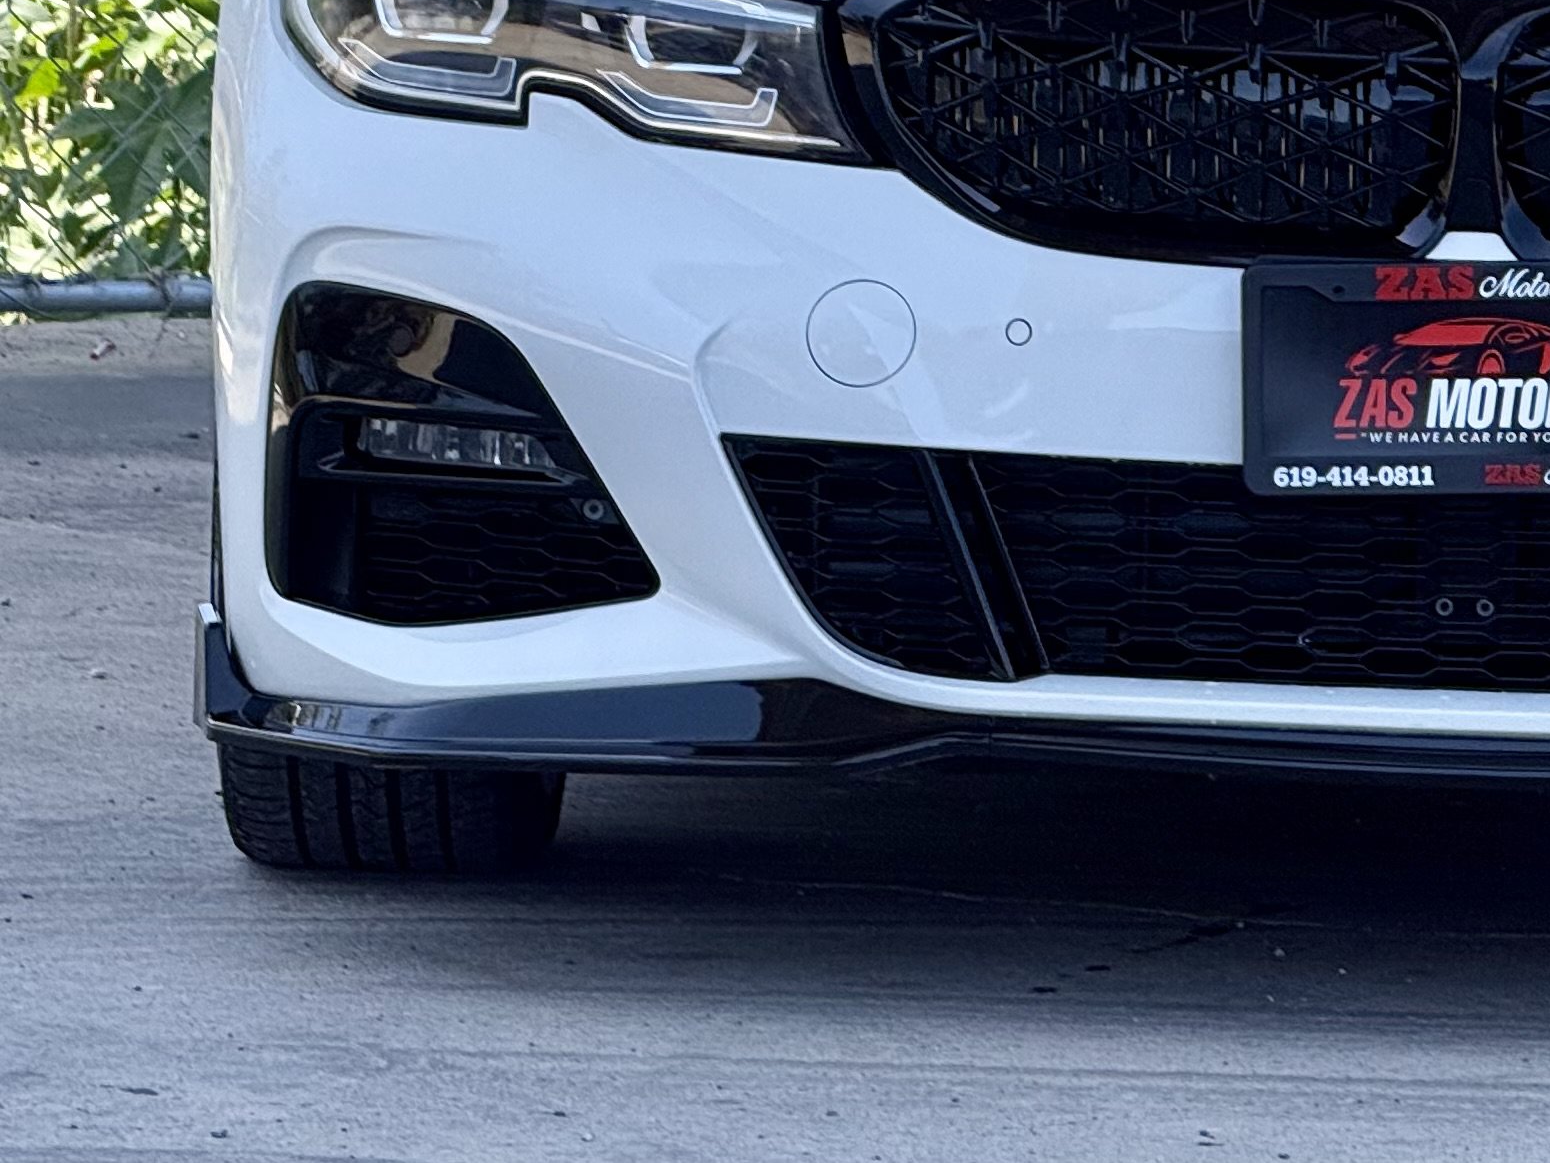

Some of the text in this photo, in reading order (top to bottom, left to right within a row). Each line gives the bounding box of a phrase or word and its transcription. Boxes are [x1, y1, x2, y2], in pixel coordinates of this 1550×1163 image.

[1375, 266, 1475, 300] ZAS
[1333, 378, 1417, 428] ZAS
[1399, 432, 1440, 443] HAVE
[1444, 432, 1455, 443] A
[1459, 432, 1491, 443] CAR
[1496, 432, 1528, 443] FOR
[1273, 465, 1435, 487] 619-414-0811
[1484, 463, 1542, 485] ZAS
